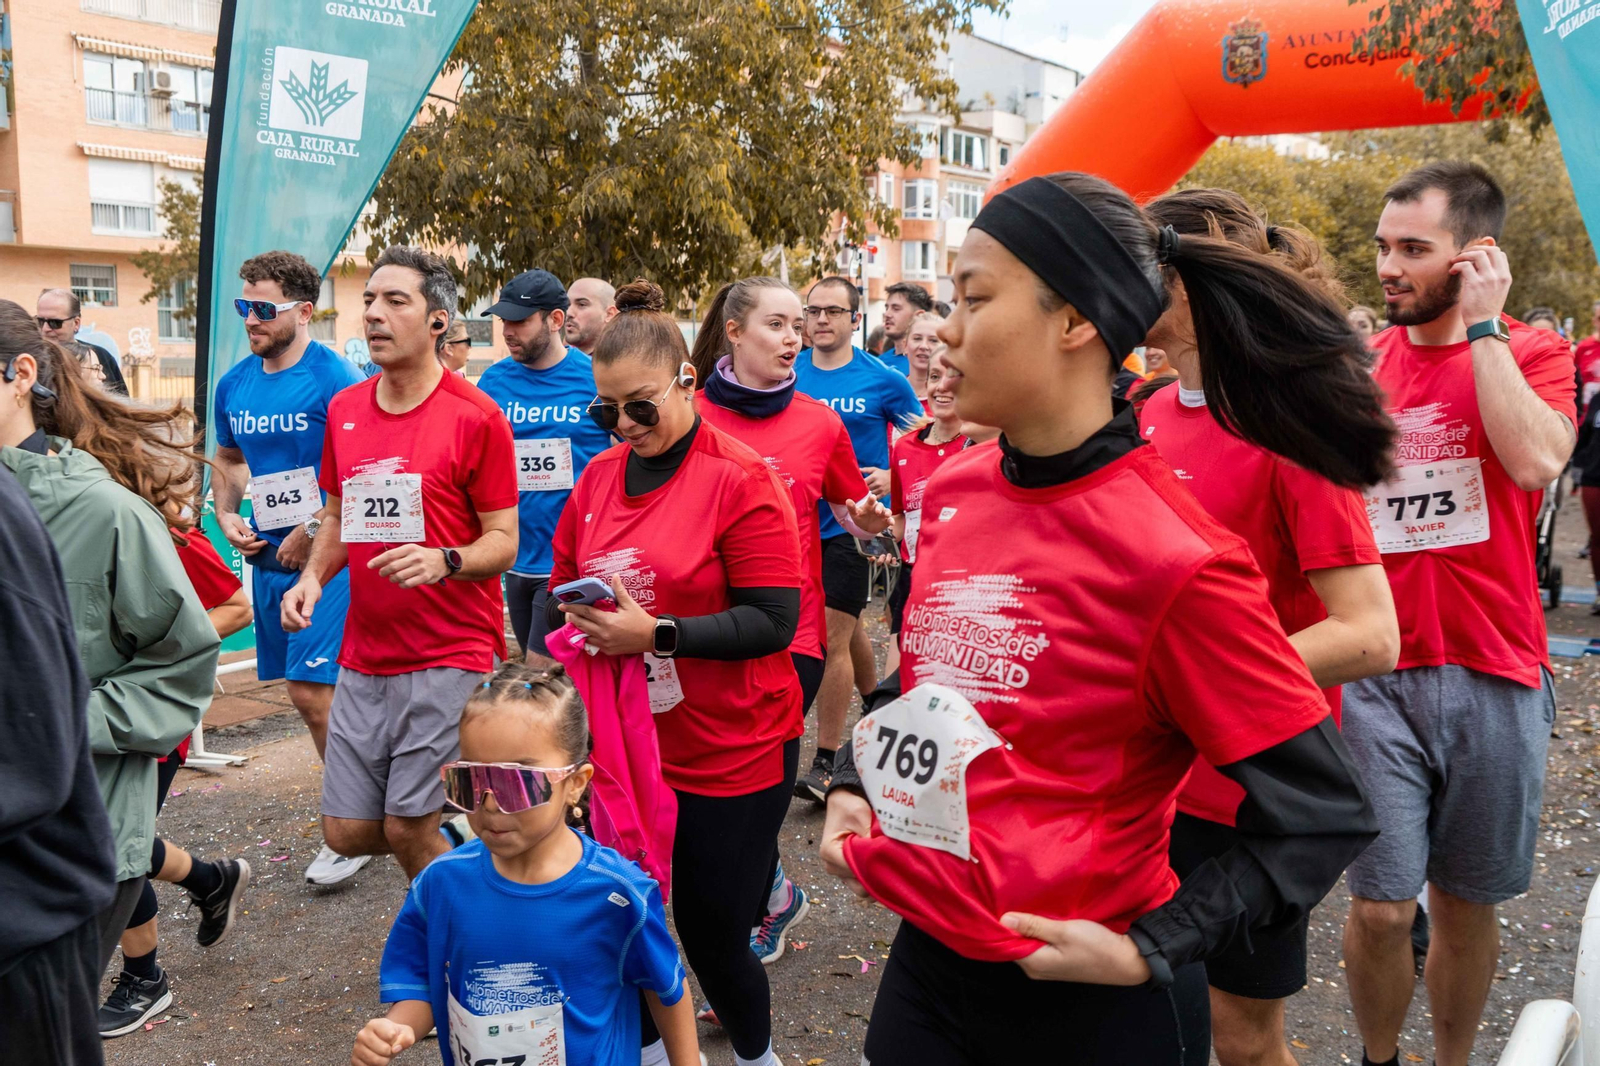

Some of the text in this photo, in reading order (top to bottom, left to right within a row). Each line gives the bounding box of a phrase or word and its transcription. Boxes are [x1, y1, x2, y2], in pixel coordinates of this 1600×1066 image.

[325, 2, 406, 28] GRANADA
[256, 47, 274, 127] fundación
[256, 129, 360, 158] CAJA RURAL
[274, 148, 336, 166] GRANADA
[228, 410, 309, 435] hiberus
[1444, 428, 1467, 442] de
[520, 456, 556, 473] 336
[265, 488, 302, 509] 843
[363, 497, 400, 518] 212
[1386, 490, 1457, 522] 773
[365, 521, 401, 529] EDUARDO
[1404, 521, 1446, 534] JAVIER
[907, 603, 1039, 662] kilómetros de
[902, 631, 1030, 689] HUMANIDAD
[875, 725, 939, 785] 769
[882, 784, 916, 809] LAURA
[465, 980, 560, 1005] kilómetros de
